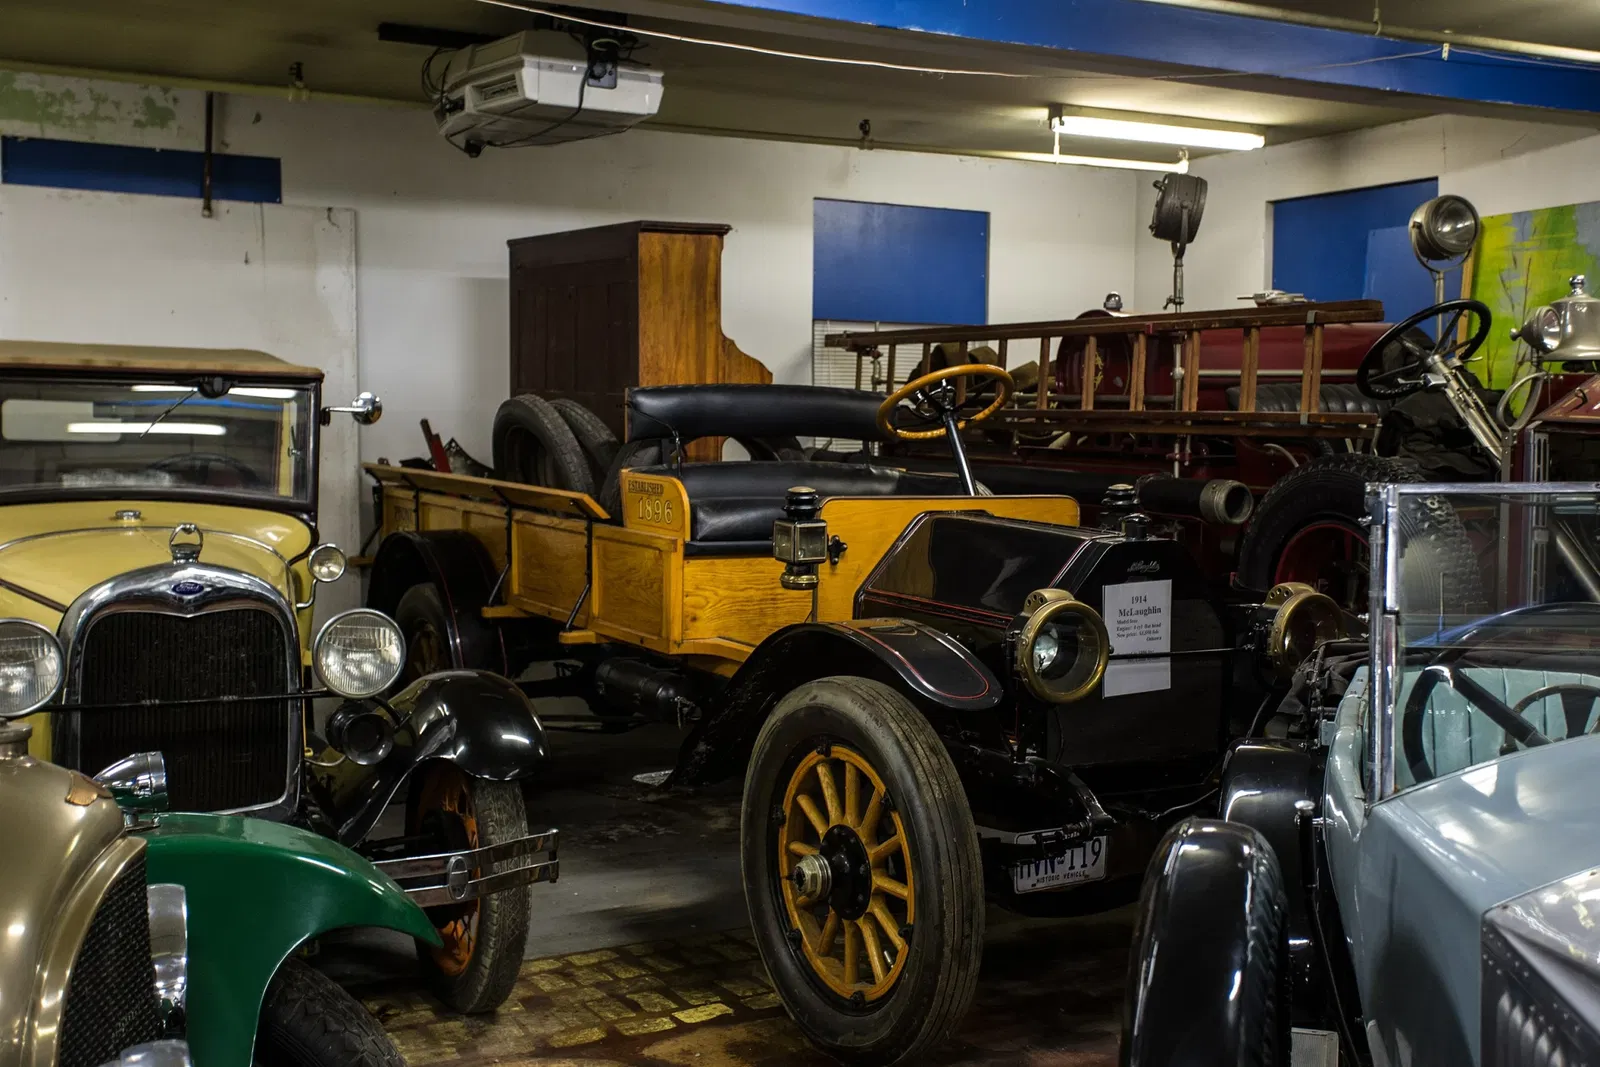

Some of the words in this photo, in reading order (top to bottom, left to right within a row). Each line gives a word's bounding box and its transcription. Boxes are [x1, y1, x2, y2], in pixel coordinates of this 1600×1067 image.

[628, 480, 664, 495] ESTABLISHED
[638, 496, 673, 524] 1896
[1131, 595, 1147, 605] 1914
[1118, 606, 1162, 618] McLaughlin
[1068, 838, 1102, 871] 119
[1036, 874, 1060, 884] HISTORIC
[1063, 870, 1086, 879] VEHICLE
